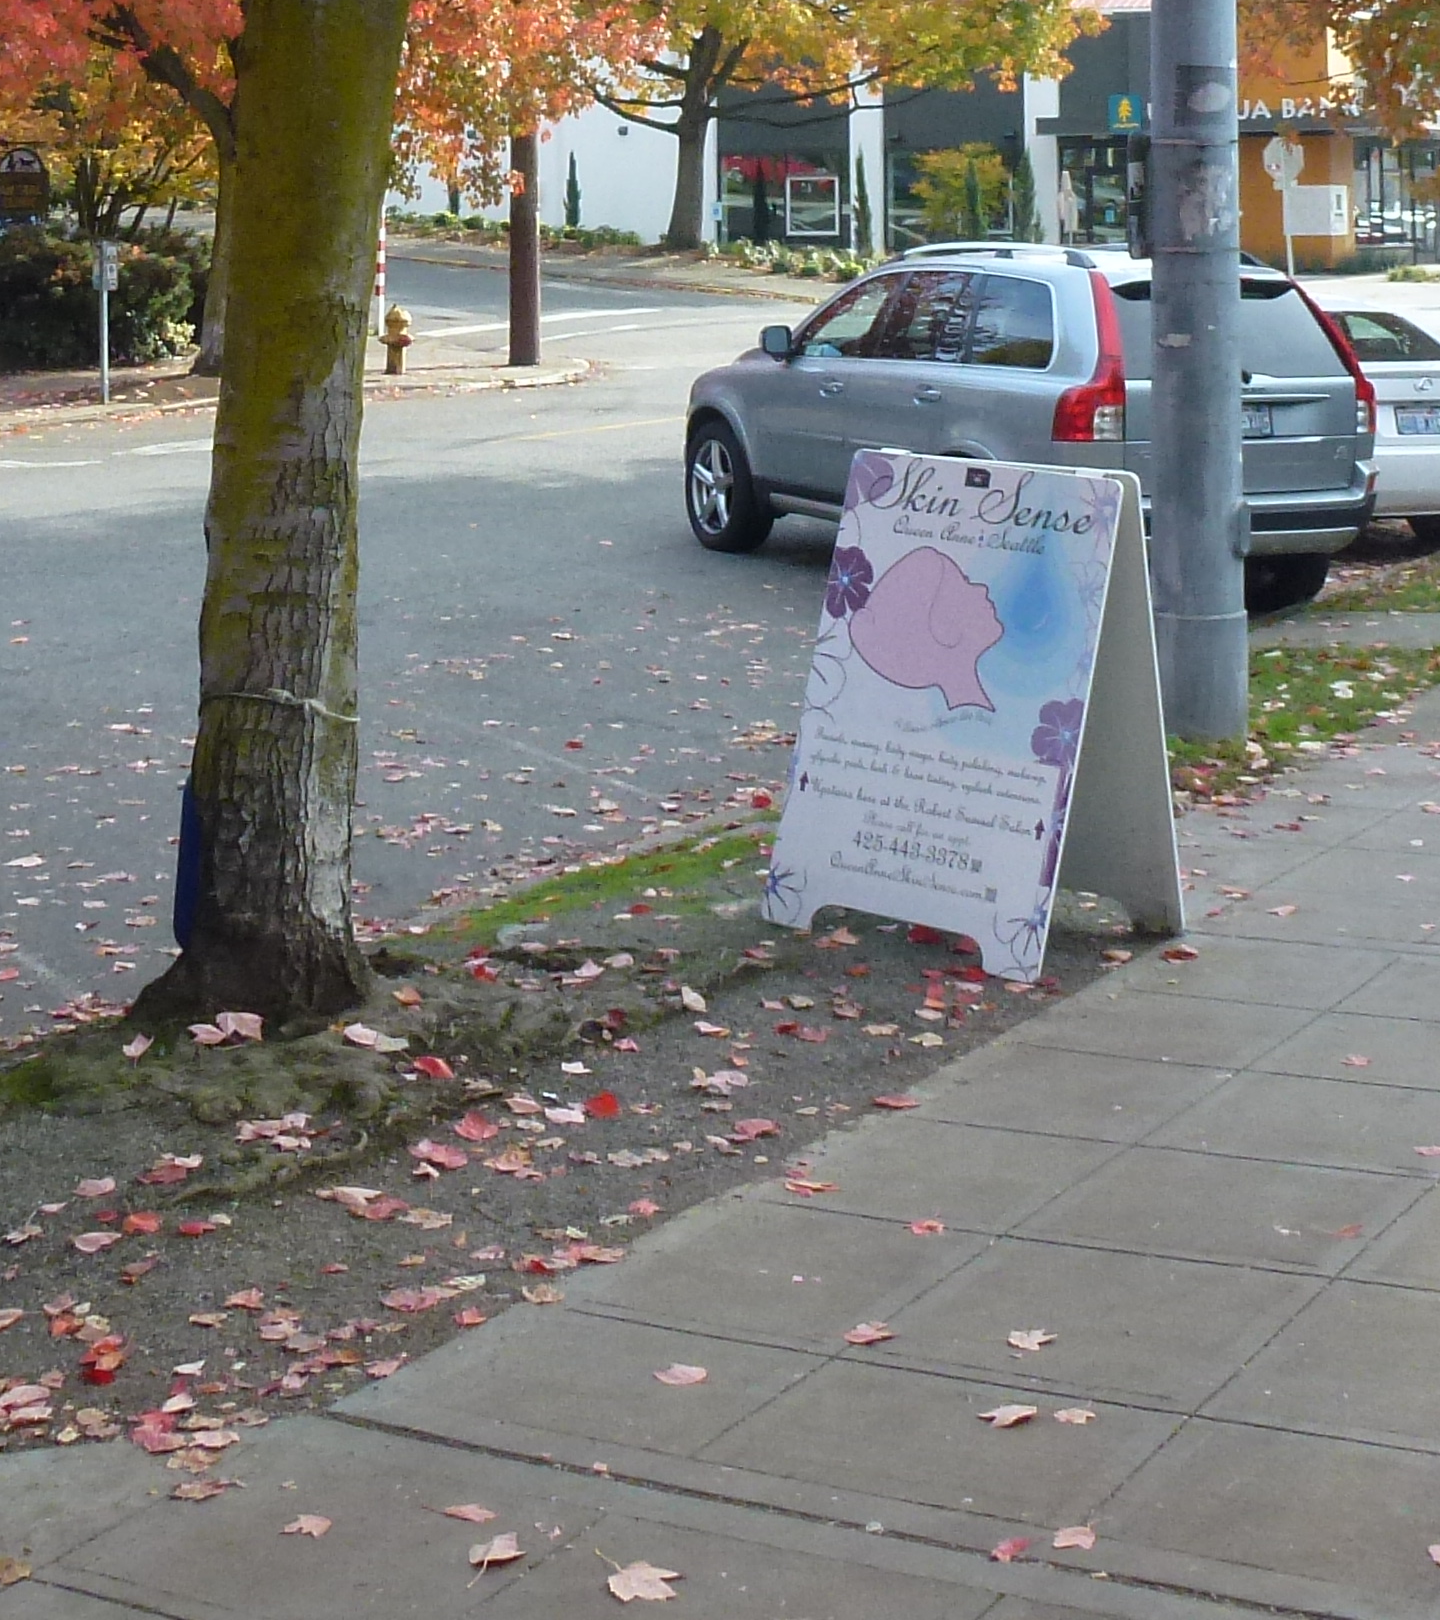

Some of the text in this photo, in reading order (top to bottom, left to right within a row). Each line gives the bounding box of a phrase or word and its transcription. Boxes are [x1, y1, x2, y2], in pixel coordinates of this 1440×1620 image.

[860, 457, 1095, 535] Skin Sense
[893, 515, 934, 539] Queen
[940, 522, 976, 546] Anne
